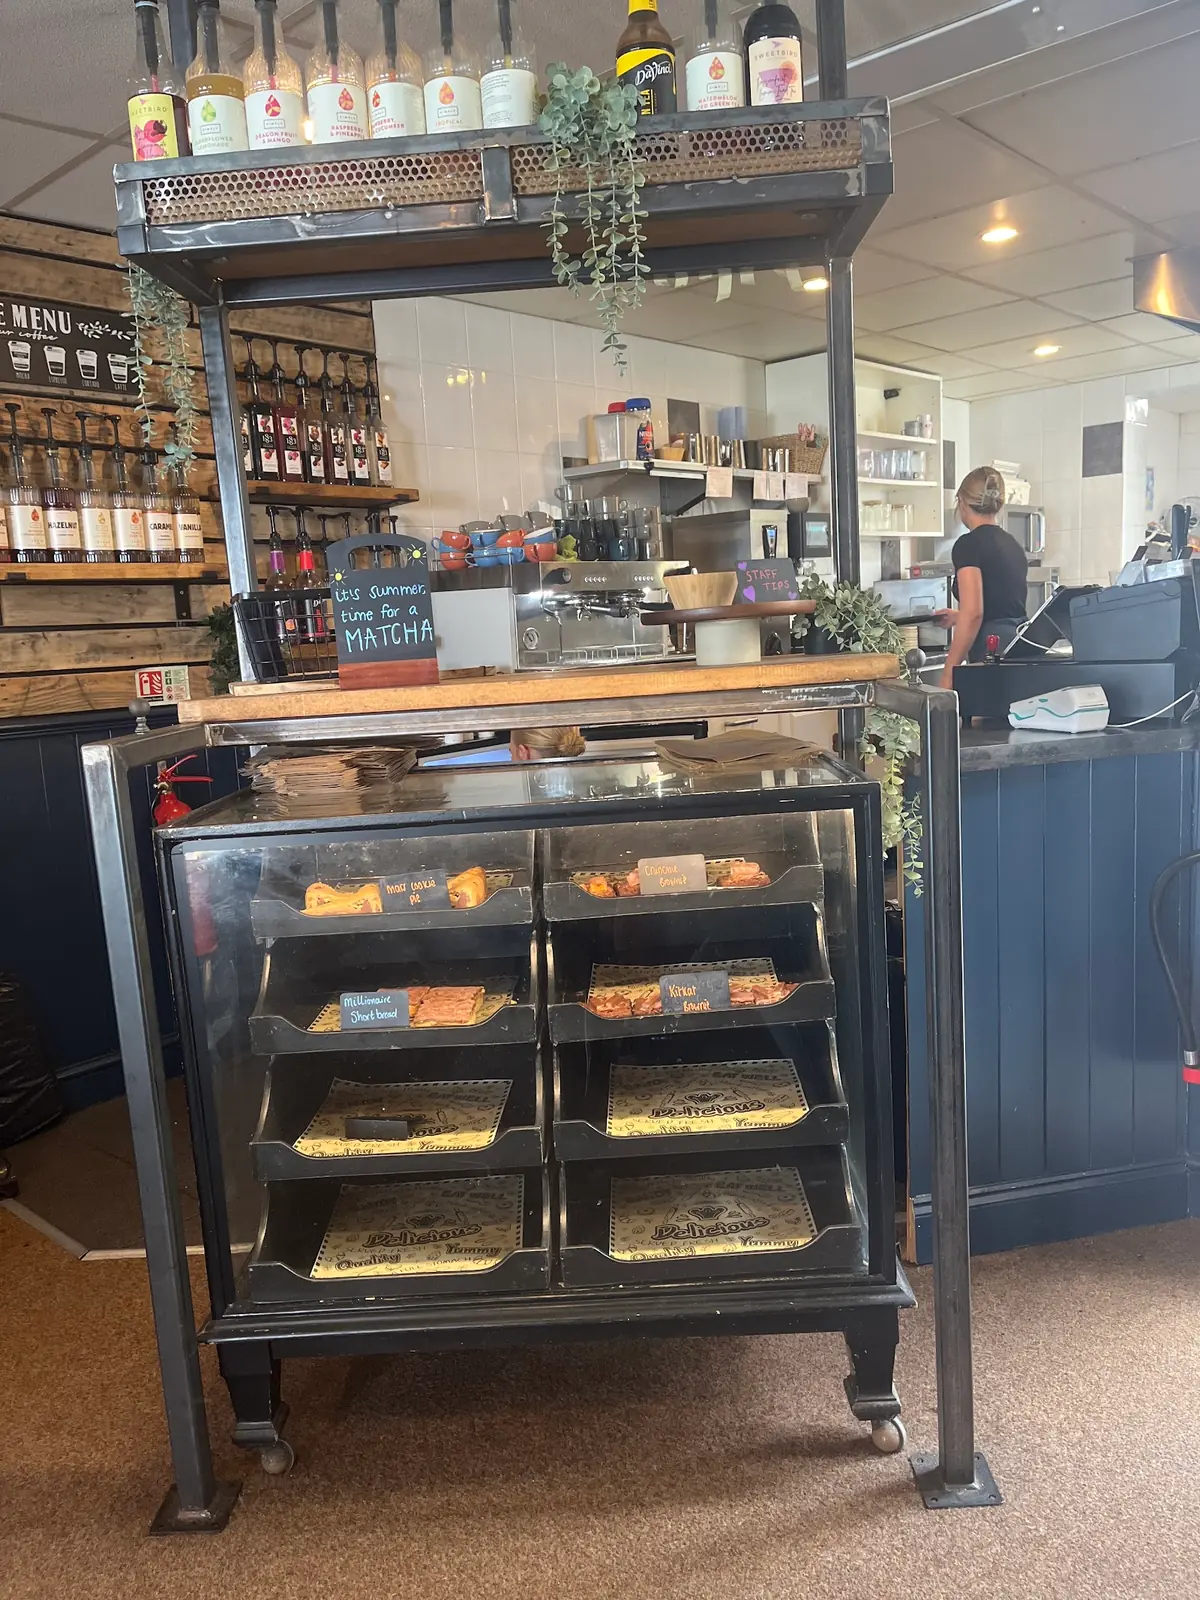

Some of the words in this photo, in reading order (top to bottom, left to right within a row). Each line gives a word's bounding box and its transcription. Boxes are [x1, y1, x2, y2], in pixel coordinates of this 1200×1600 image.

[634, 61, 672, 86] DaVinci
[11, 304, 72, 334] MENU
[150, 522, 173, 530] CARAME
[745, 568, 778, 582] STAFF
[762, 580, 790, 591] TIPS
[341, 608, 374, 623] time
[381, 603, 400, 618] for
[408, 606, 418, 616] a
[345, 618, 433, 652] MATCHA
[409, 891, 421, 906] pie
[344, 995, 391, 1008] Millionaire
[648, 1099, 766, 1119] Delicious
[362, 1223, 483, 1248] Delicious
[651, 1216, 770, 1240] Delicious
[335, 1253, 402, 1271] Quality
